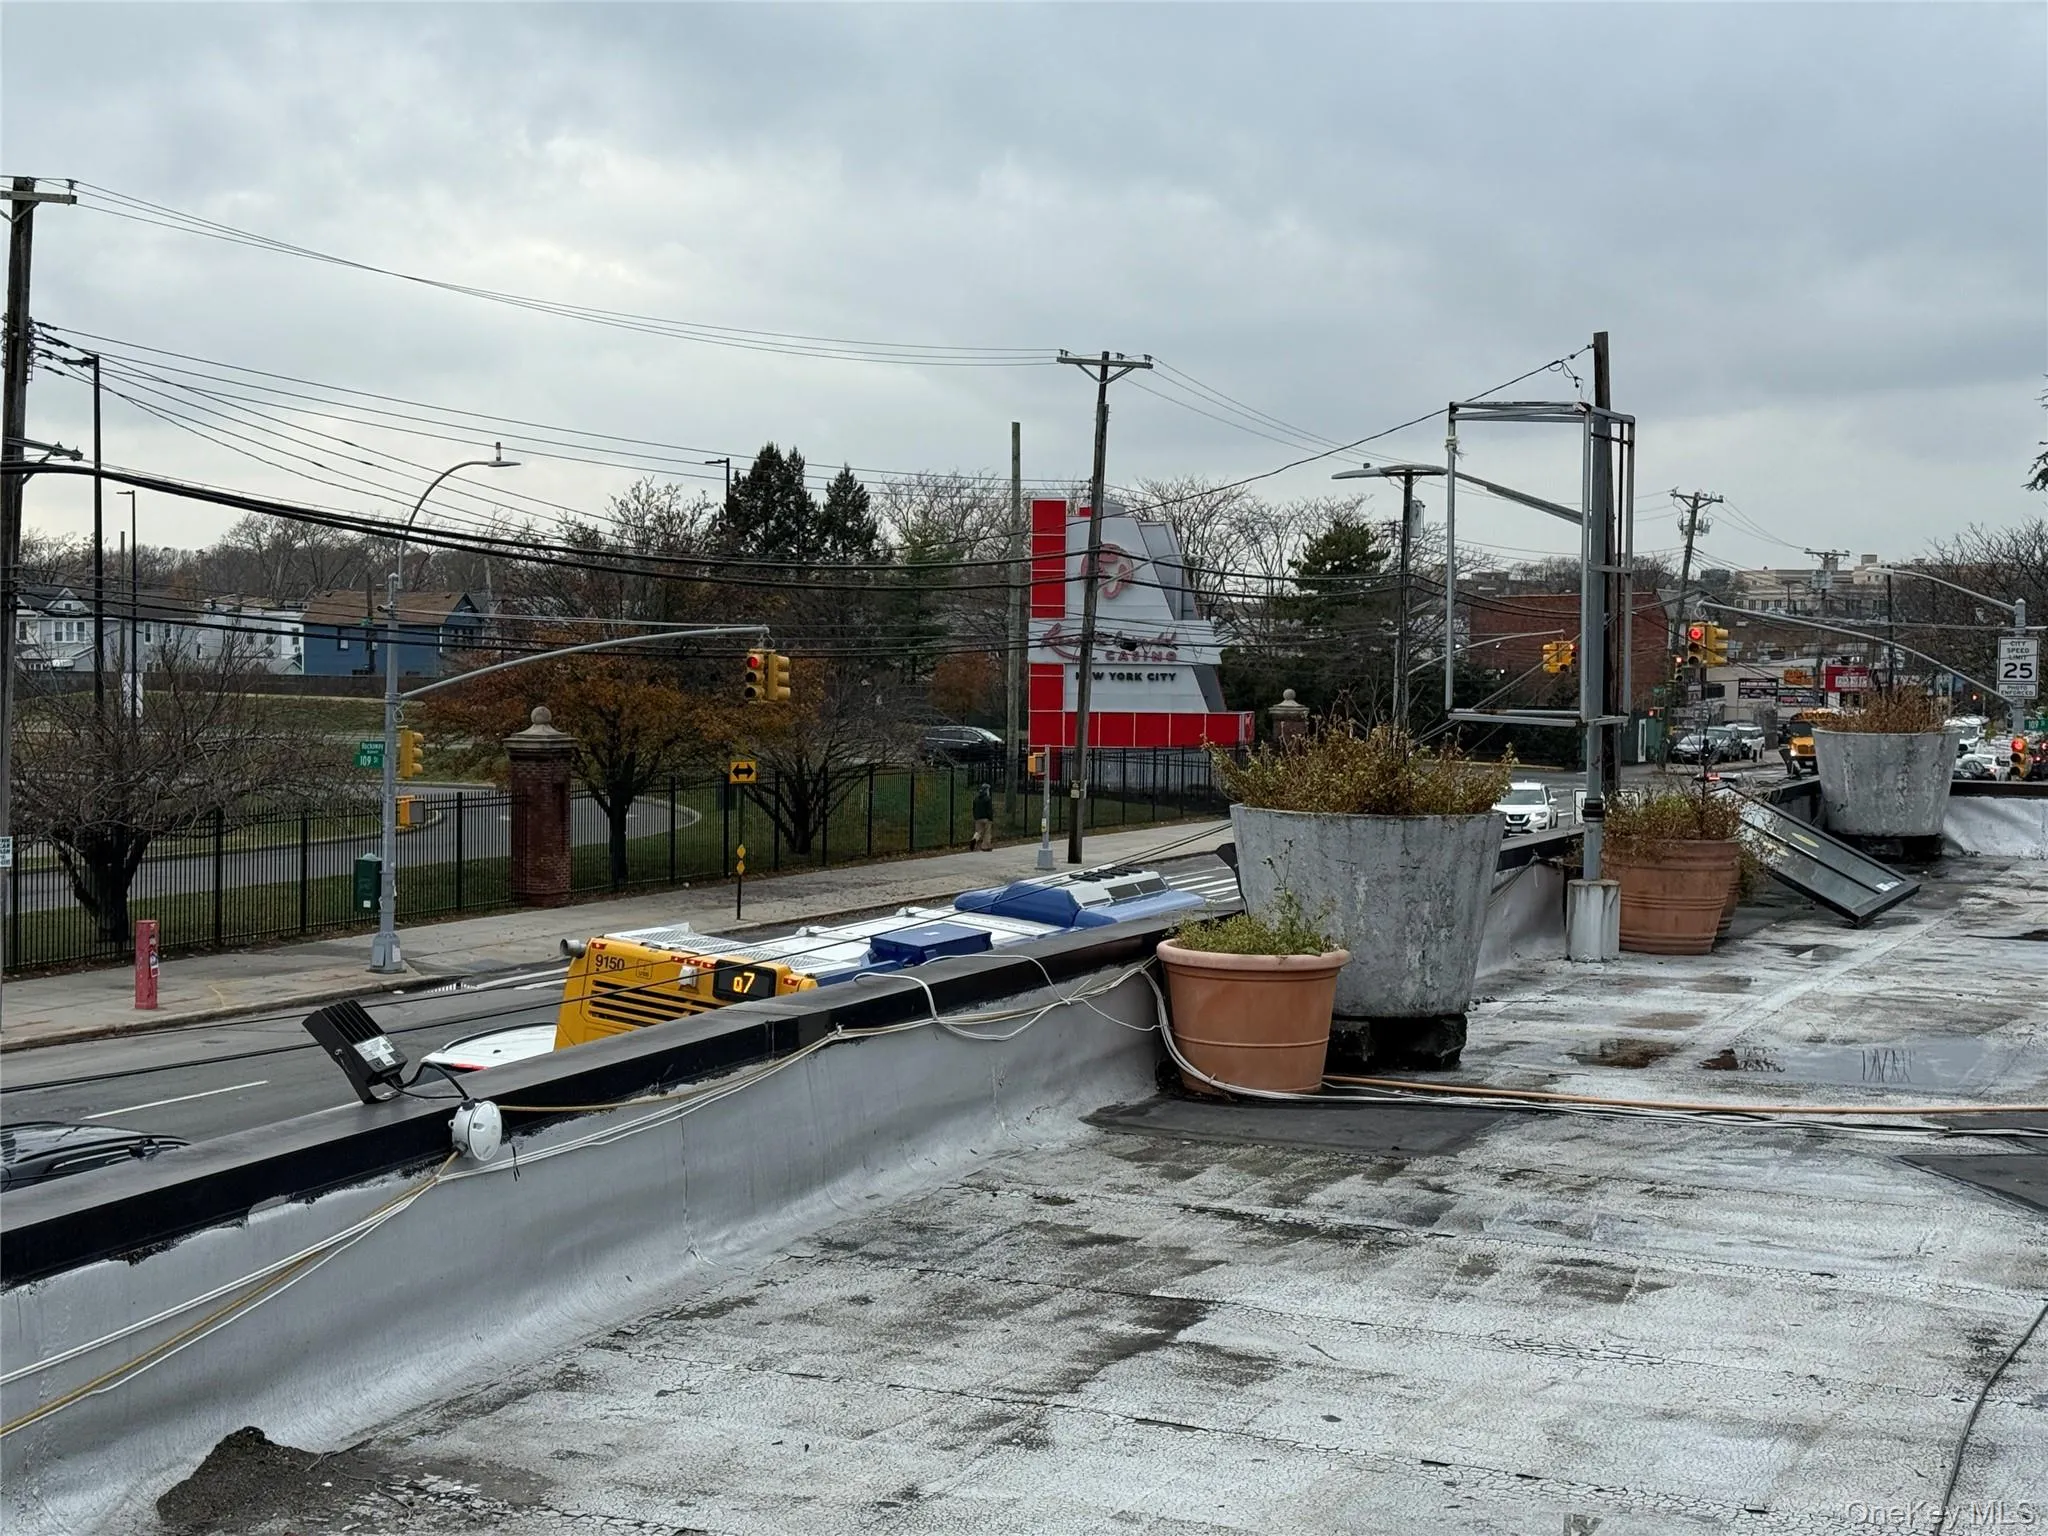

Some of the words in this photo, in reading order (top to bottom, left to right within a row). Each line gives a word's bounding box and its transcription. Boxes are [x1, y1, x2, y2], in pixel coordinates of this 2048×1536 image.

[1105, 651, 1177, 662] CASINO
[1108, 671, 1143, 682] YORK
[1147, 671, 1177, 682] CITY
[2003, 662, 2033, 679] 25
[360, 755, 371, 767] 109
[595, 954, 625, 971] 9150
